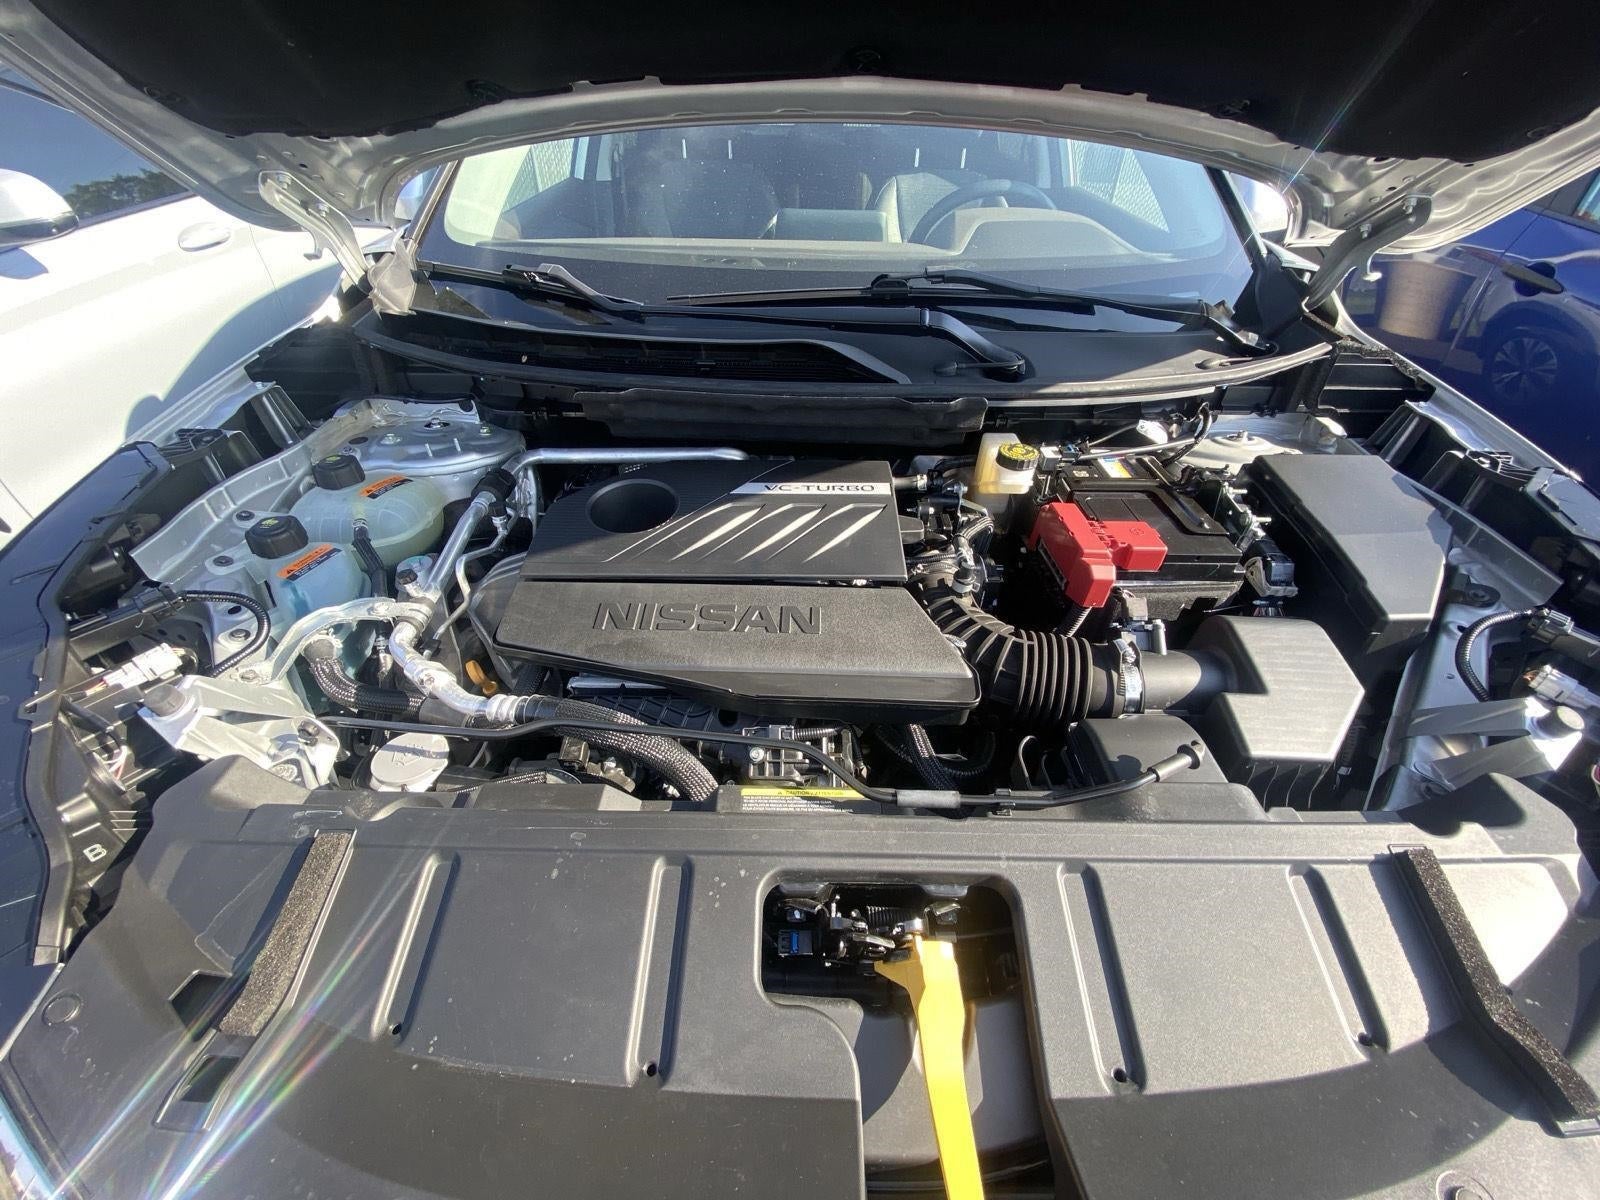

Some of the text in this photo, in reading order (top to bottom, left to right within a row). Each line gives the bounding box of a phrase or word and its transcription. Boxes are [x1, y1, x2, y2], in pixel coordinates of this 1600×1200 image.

[764, 484, 875, 492] VC-TURBO
[593, 602, 822, 635] NISSAN
[83, 843, 107, 862] B
